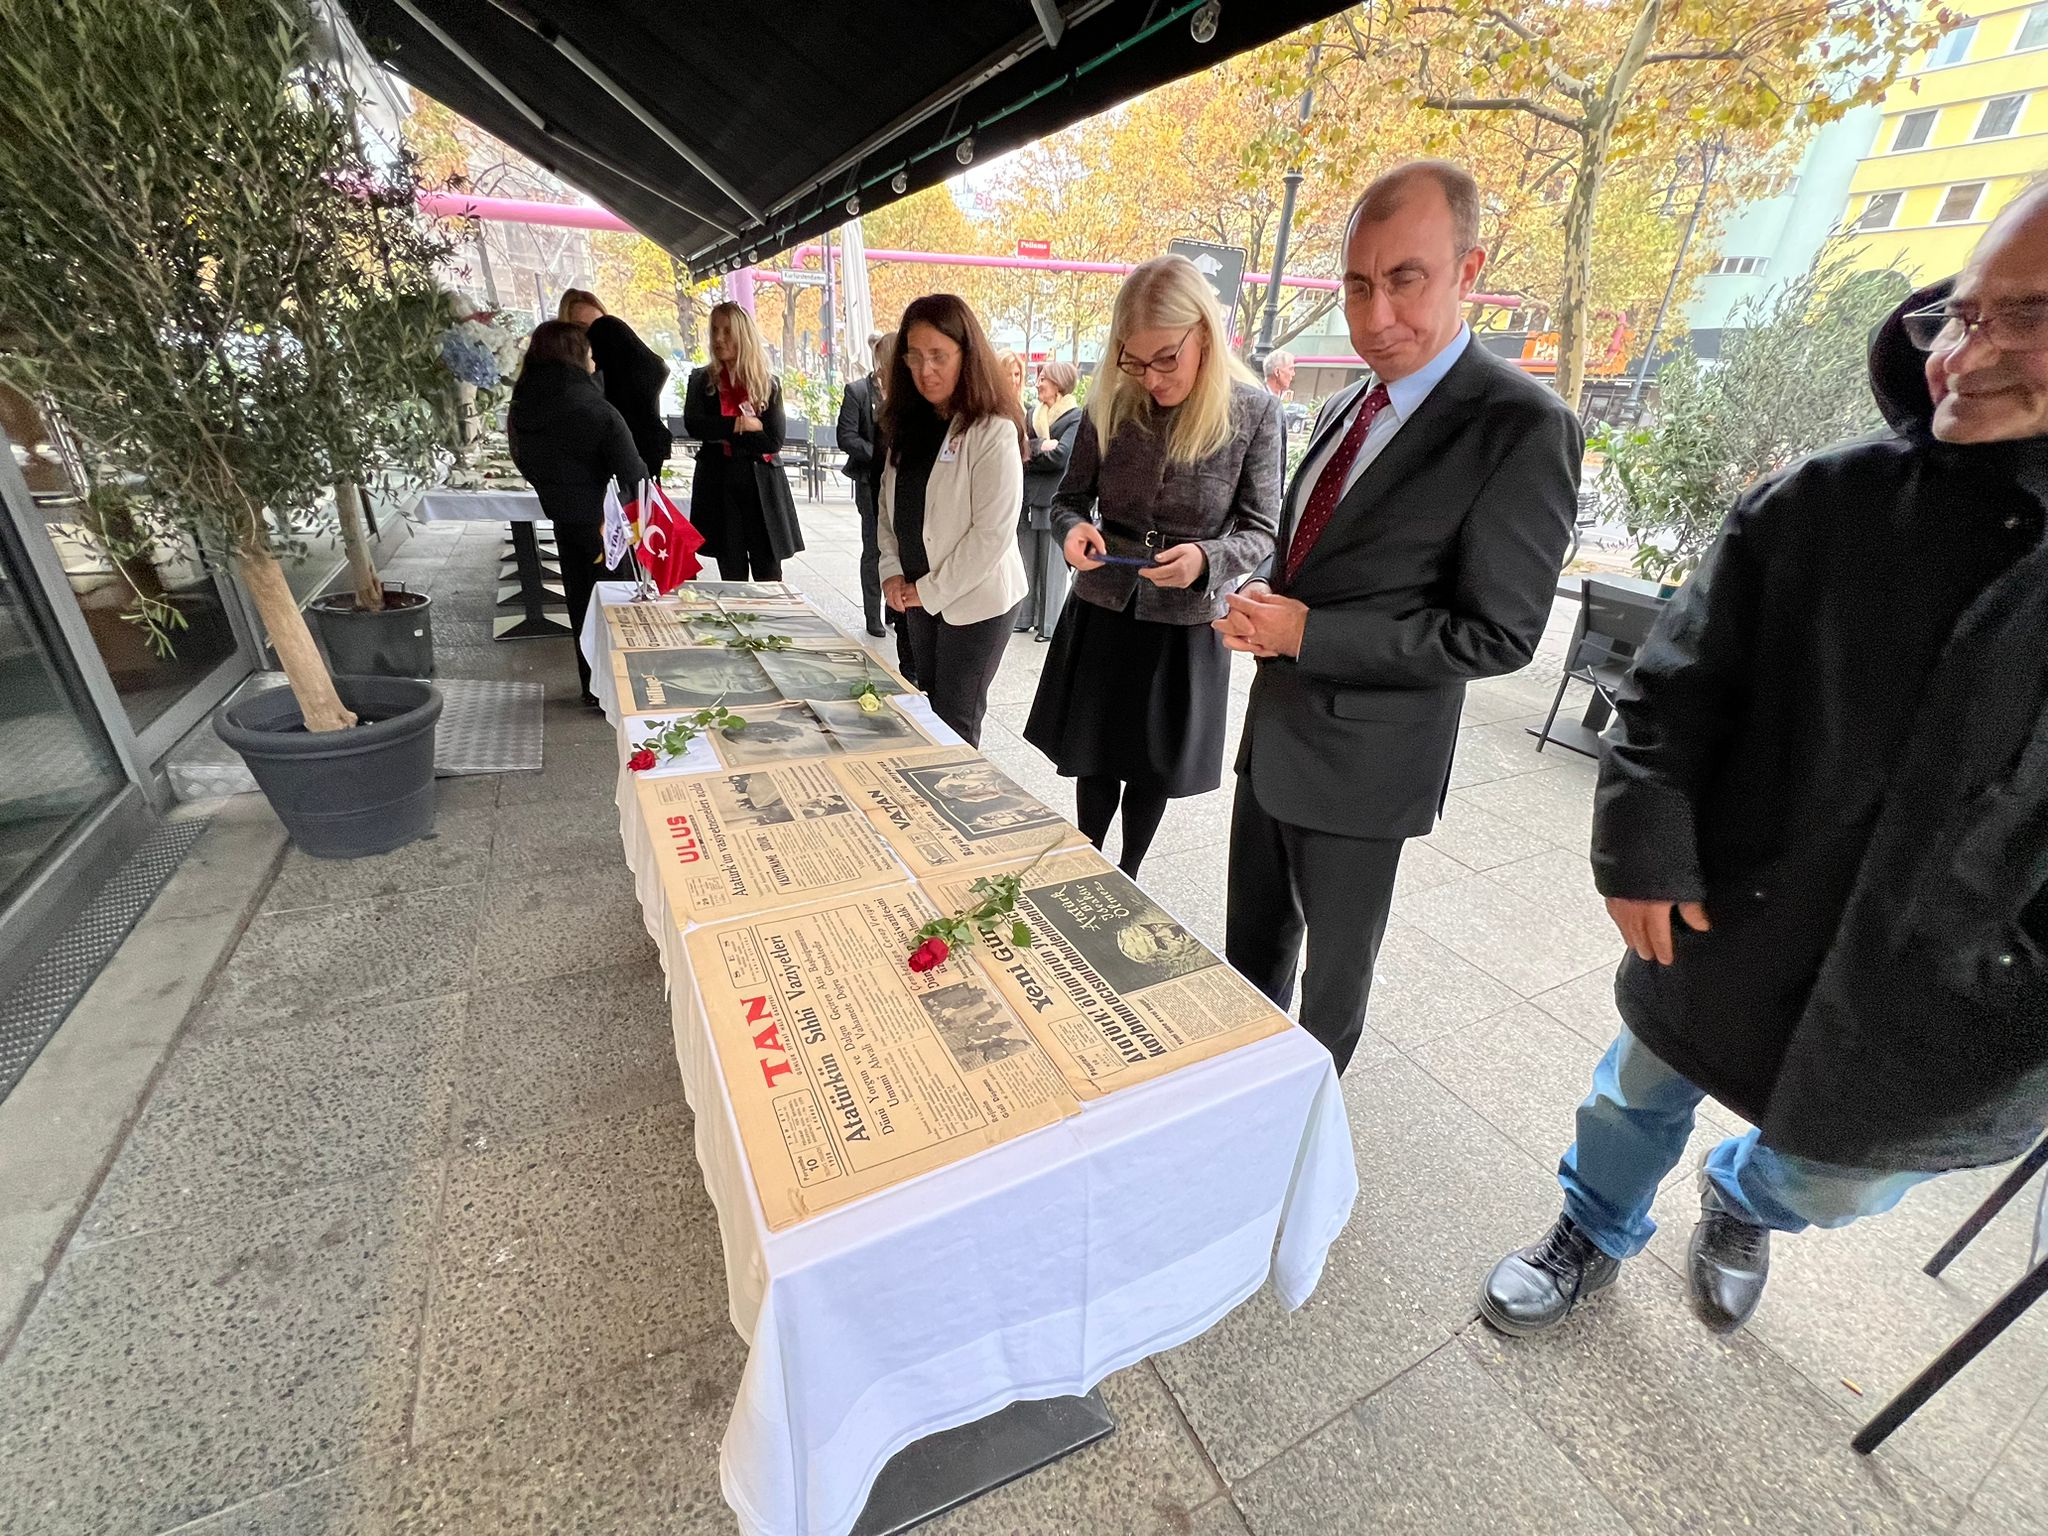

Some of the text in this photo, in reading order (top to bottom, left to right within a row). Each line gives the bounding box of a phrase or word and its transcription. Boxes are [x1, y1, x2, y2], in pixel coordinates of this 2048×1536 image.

[866, 789, 912, 831] VATAN
[666, 815, 700, 864] ULUS
[1025, 909, 1069, 948] derinden
[1050, 884, 1101, 932] Atatürk
[764, 934, 806, 1002] Vaziyetleri
[1040, 950, 1097, 1008] ölümünün
[1058, 945, 1090, 972] daha
[1005, 963, 1054, 1014] Yeni
[1079, 969, 1121, 1006] acısını
[739, 995, 793, 1089] TAN
[794, 1006, 827, 1045] Sıhhî
[839, 1024, 856, 1052] Dalgın
[1087, 1008, 1148, 1064] Atatürk!
[1111, 1003, 1168, 1058] kaybının
[853, 1054, 862, 1066] ve
[817, 1052, 871, 1142] Atatürkün
[860, 1069, 880, 1104] Yorgun
[874, 1107, 895, 1136] Dünü
[806, 1158, 820, 1172] 10
